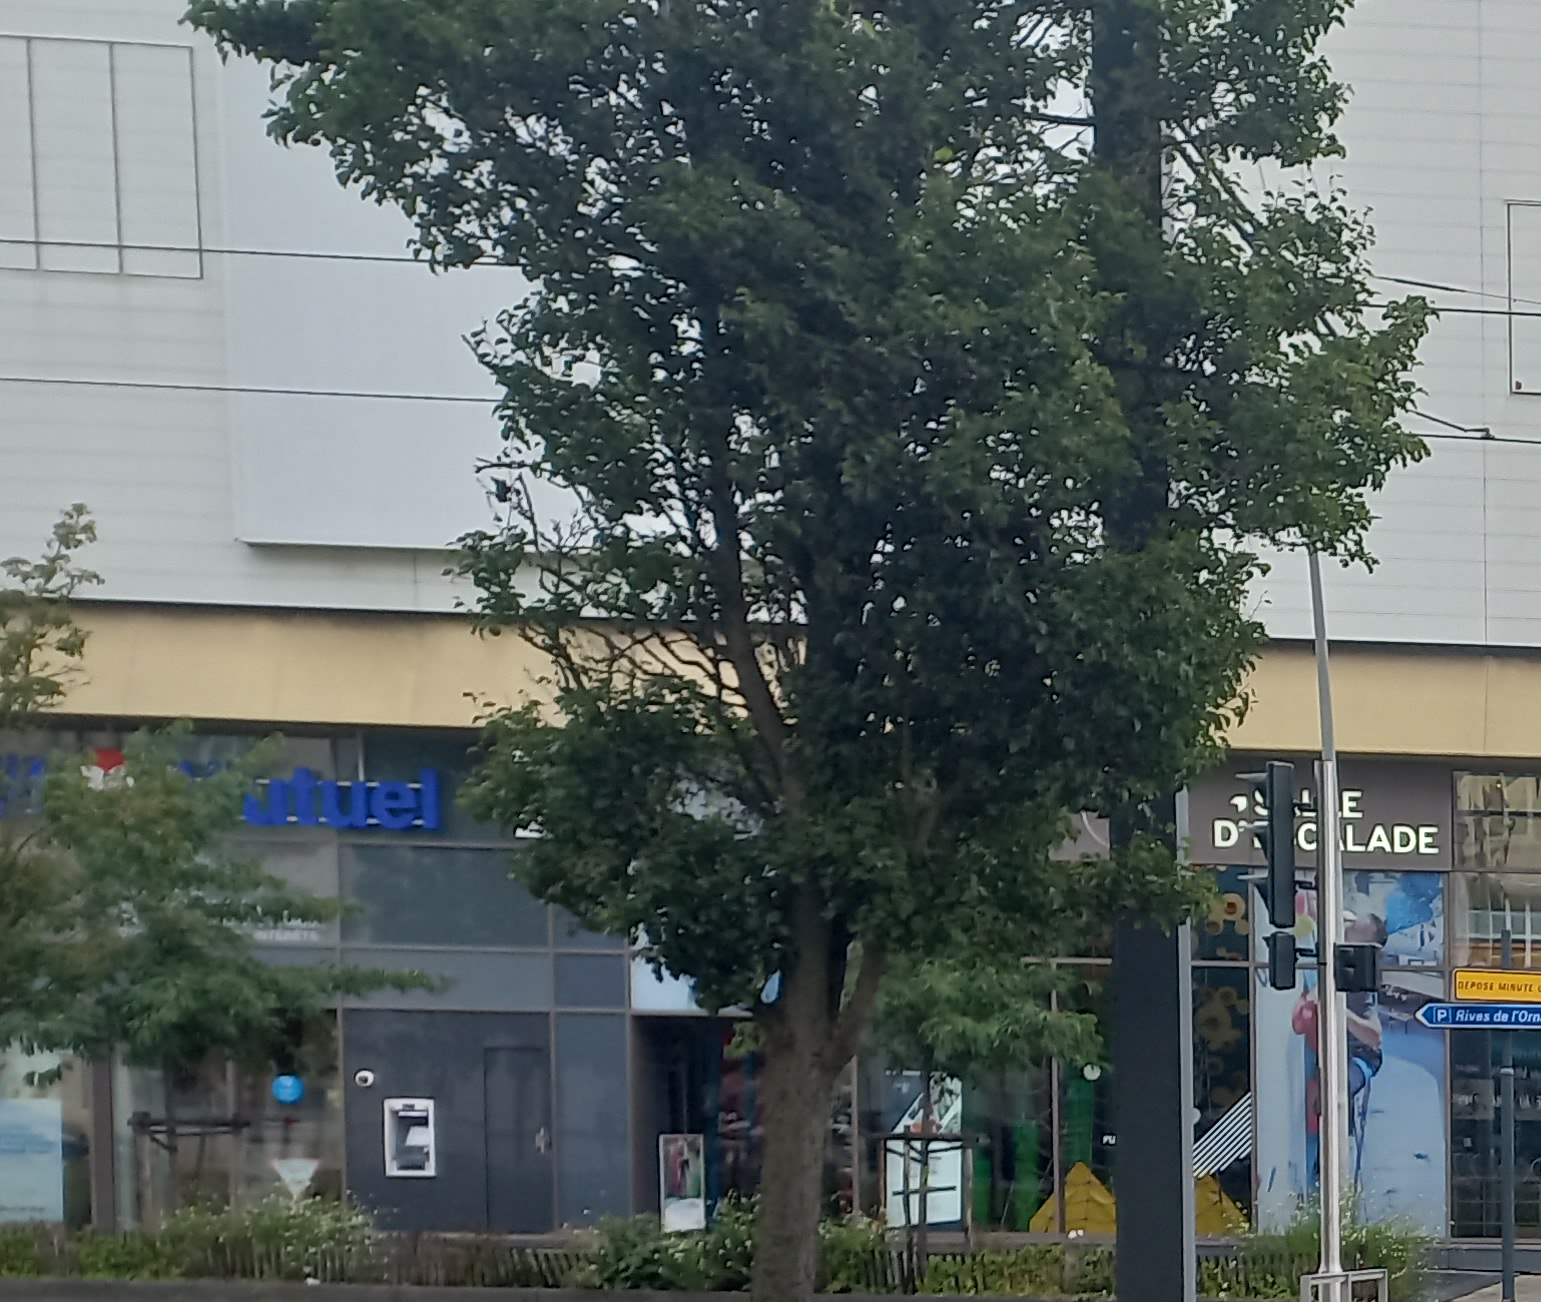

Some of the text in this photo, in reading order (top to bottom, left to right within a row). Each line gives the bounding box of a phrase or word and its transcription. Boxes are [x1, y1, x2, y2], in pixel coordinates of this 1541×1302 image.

[183, 760, 440, 830] utuel
[1253, 788, 1364, 819] SLE
[1212, 818, 1440, 855] D'CLADE
[1455, 1009, 1490, 1023] Rives
[1493, 1009, 1509, 1023] de
